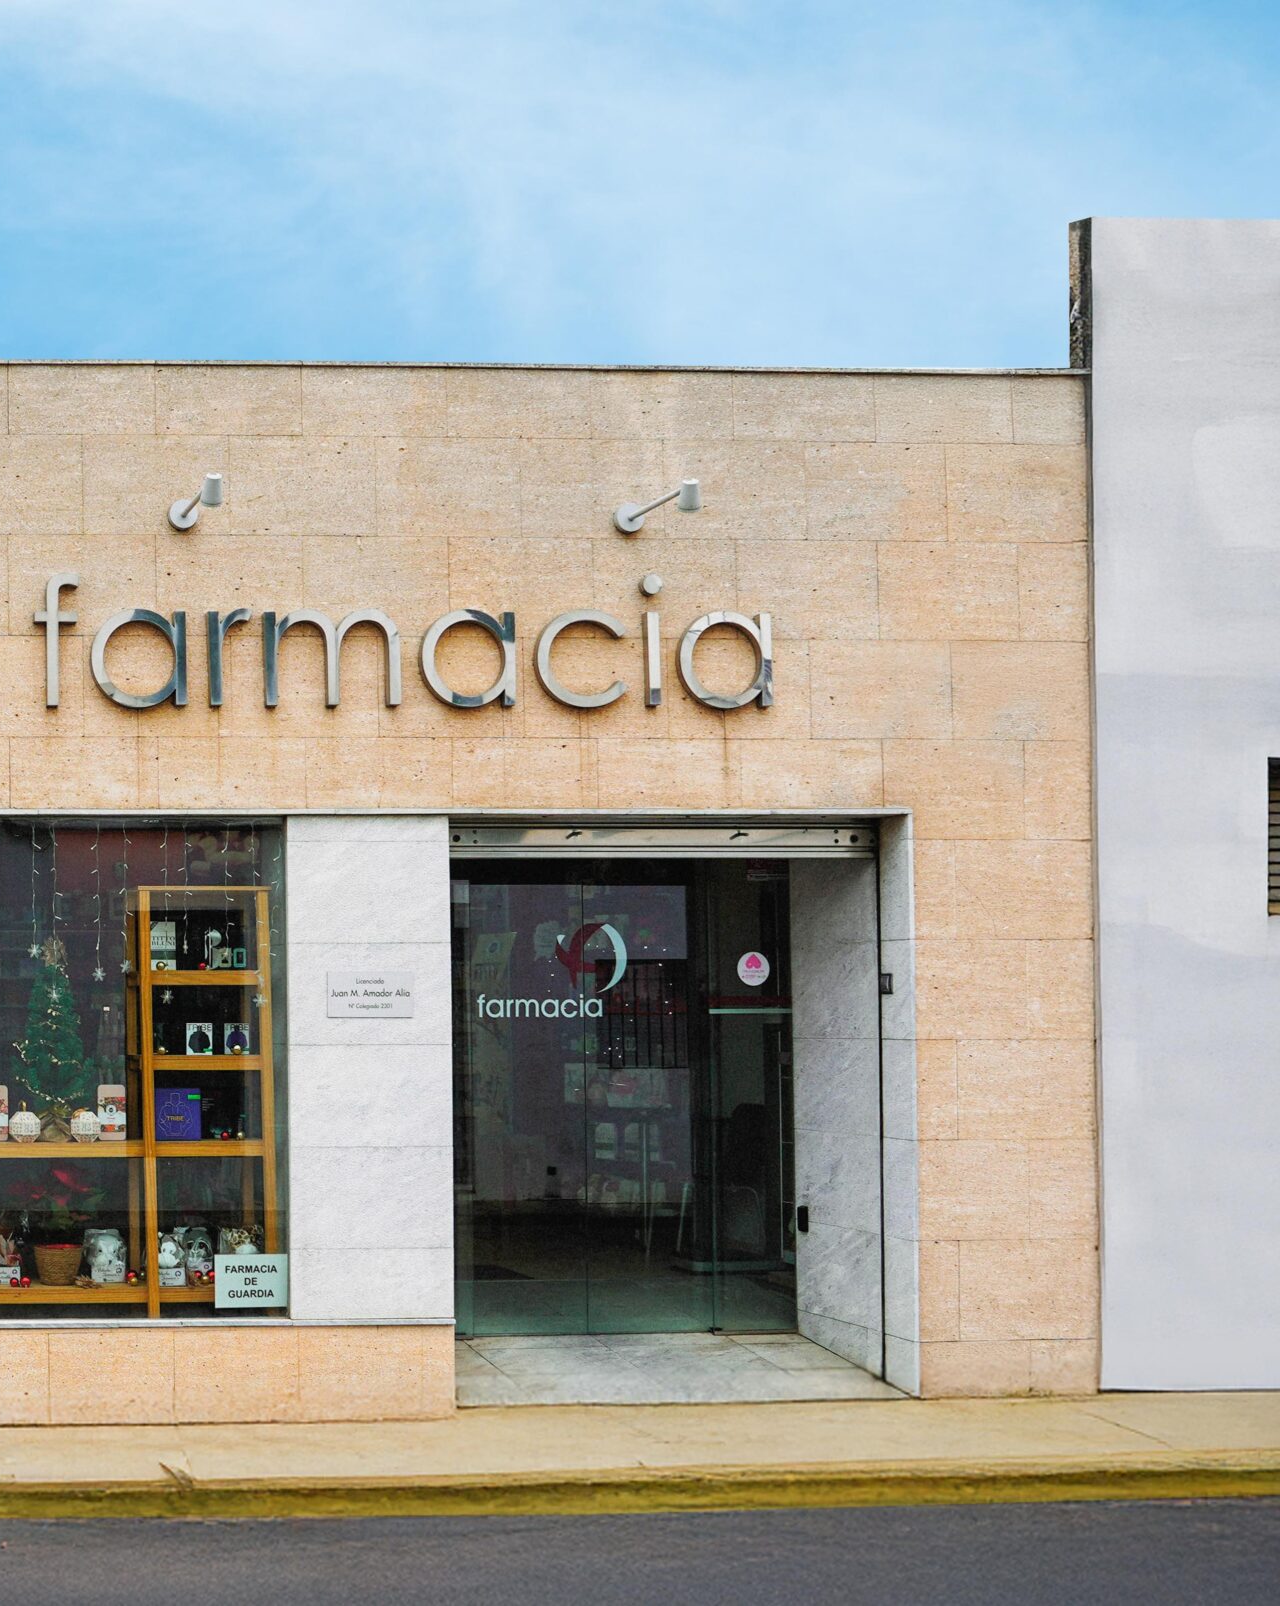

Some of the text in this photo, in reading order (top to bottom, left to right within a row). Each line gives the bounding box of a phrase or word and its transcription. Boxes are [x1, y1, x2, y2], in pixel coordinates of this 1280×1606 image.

[33, 573, 773, 709] farmacia
[355, 977, 385, 985] Licenciado
[331, 988, 349, 997] Juan
[350, 989, 360, 997] M.
[363, 987, 393, 997] Amador
[476, 993, 604, 1018] farmacia
[188, 1023, 212, 1031] TRBE
[225, 1023, 249, 1031] TRBE
[224, 1264, 278, 1274] FARMACIA
[244, 1277, 258, 1286] DE
[228, 1289, 275, 1298] GUARDIA
